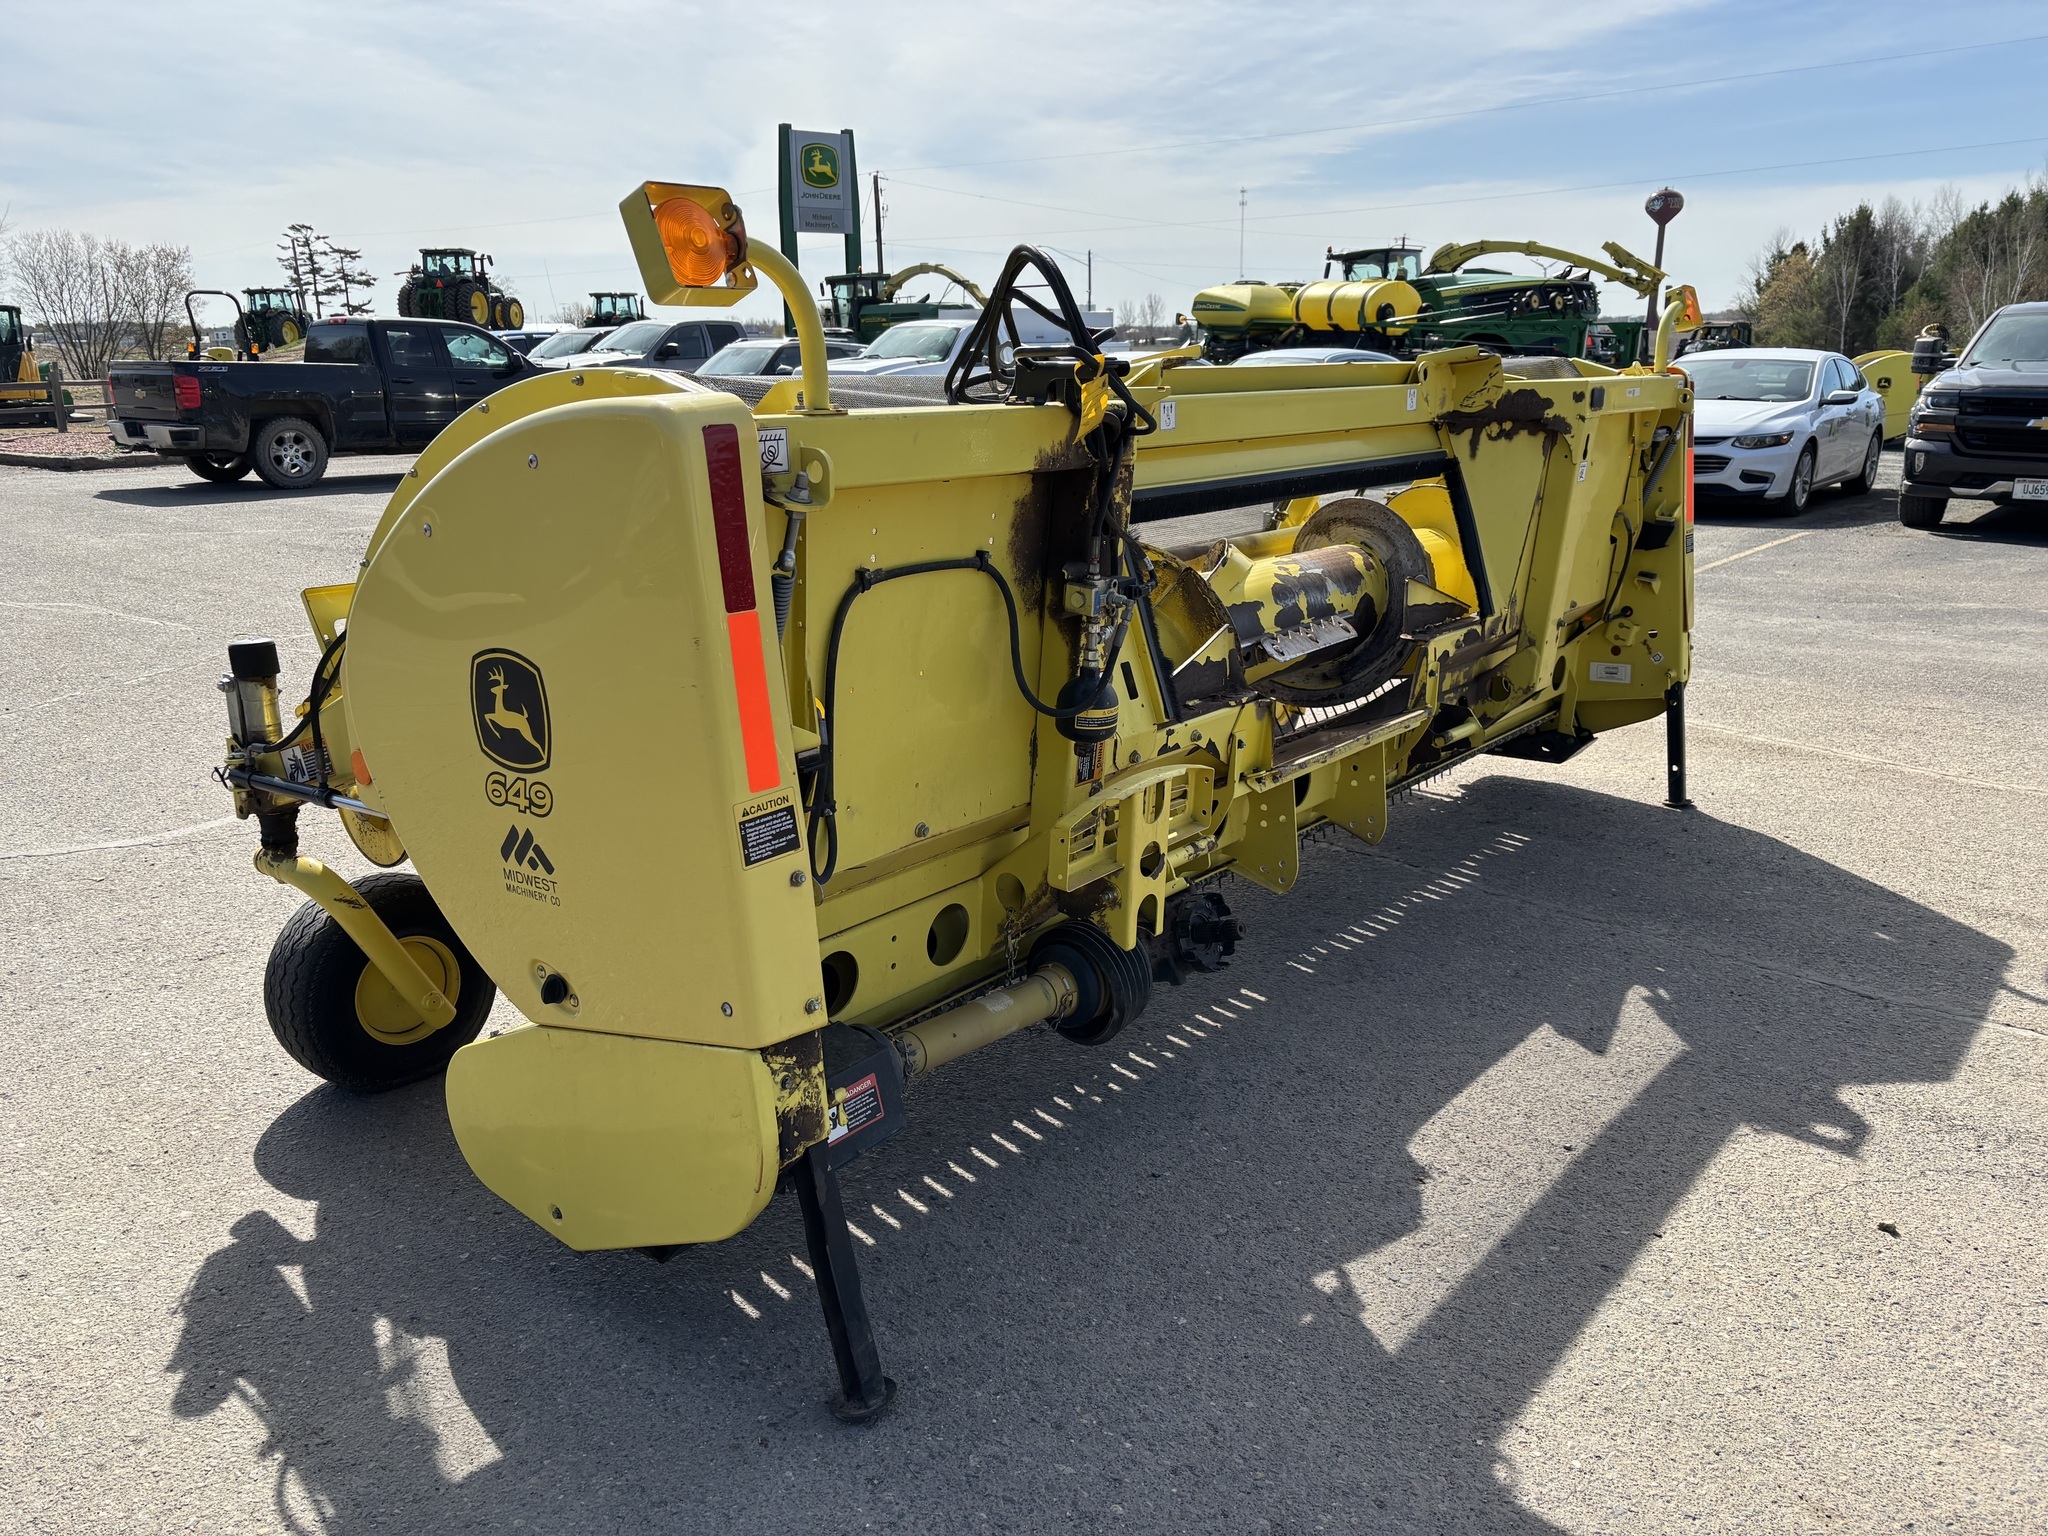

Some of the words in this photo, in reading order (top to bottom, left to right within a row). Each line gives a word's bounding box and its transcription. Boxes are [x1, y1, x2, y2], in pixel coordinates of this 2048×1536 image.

[819, 192, 842, 200] DEERE
[805, 221, 830, 230] Machinery
[812, 213, 833, 221] Midwest
[485, 771, 554, 818] 649
[749, 795, 789, 815] CAUTION
[503, 867, 558, 894] MIDWEST
[505, 883, 548, 903] MACHINERY
[550, 895, 561, 907] CO
[849, 1079, 872, 1097] DANGER
